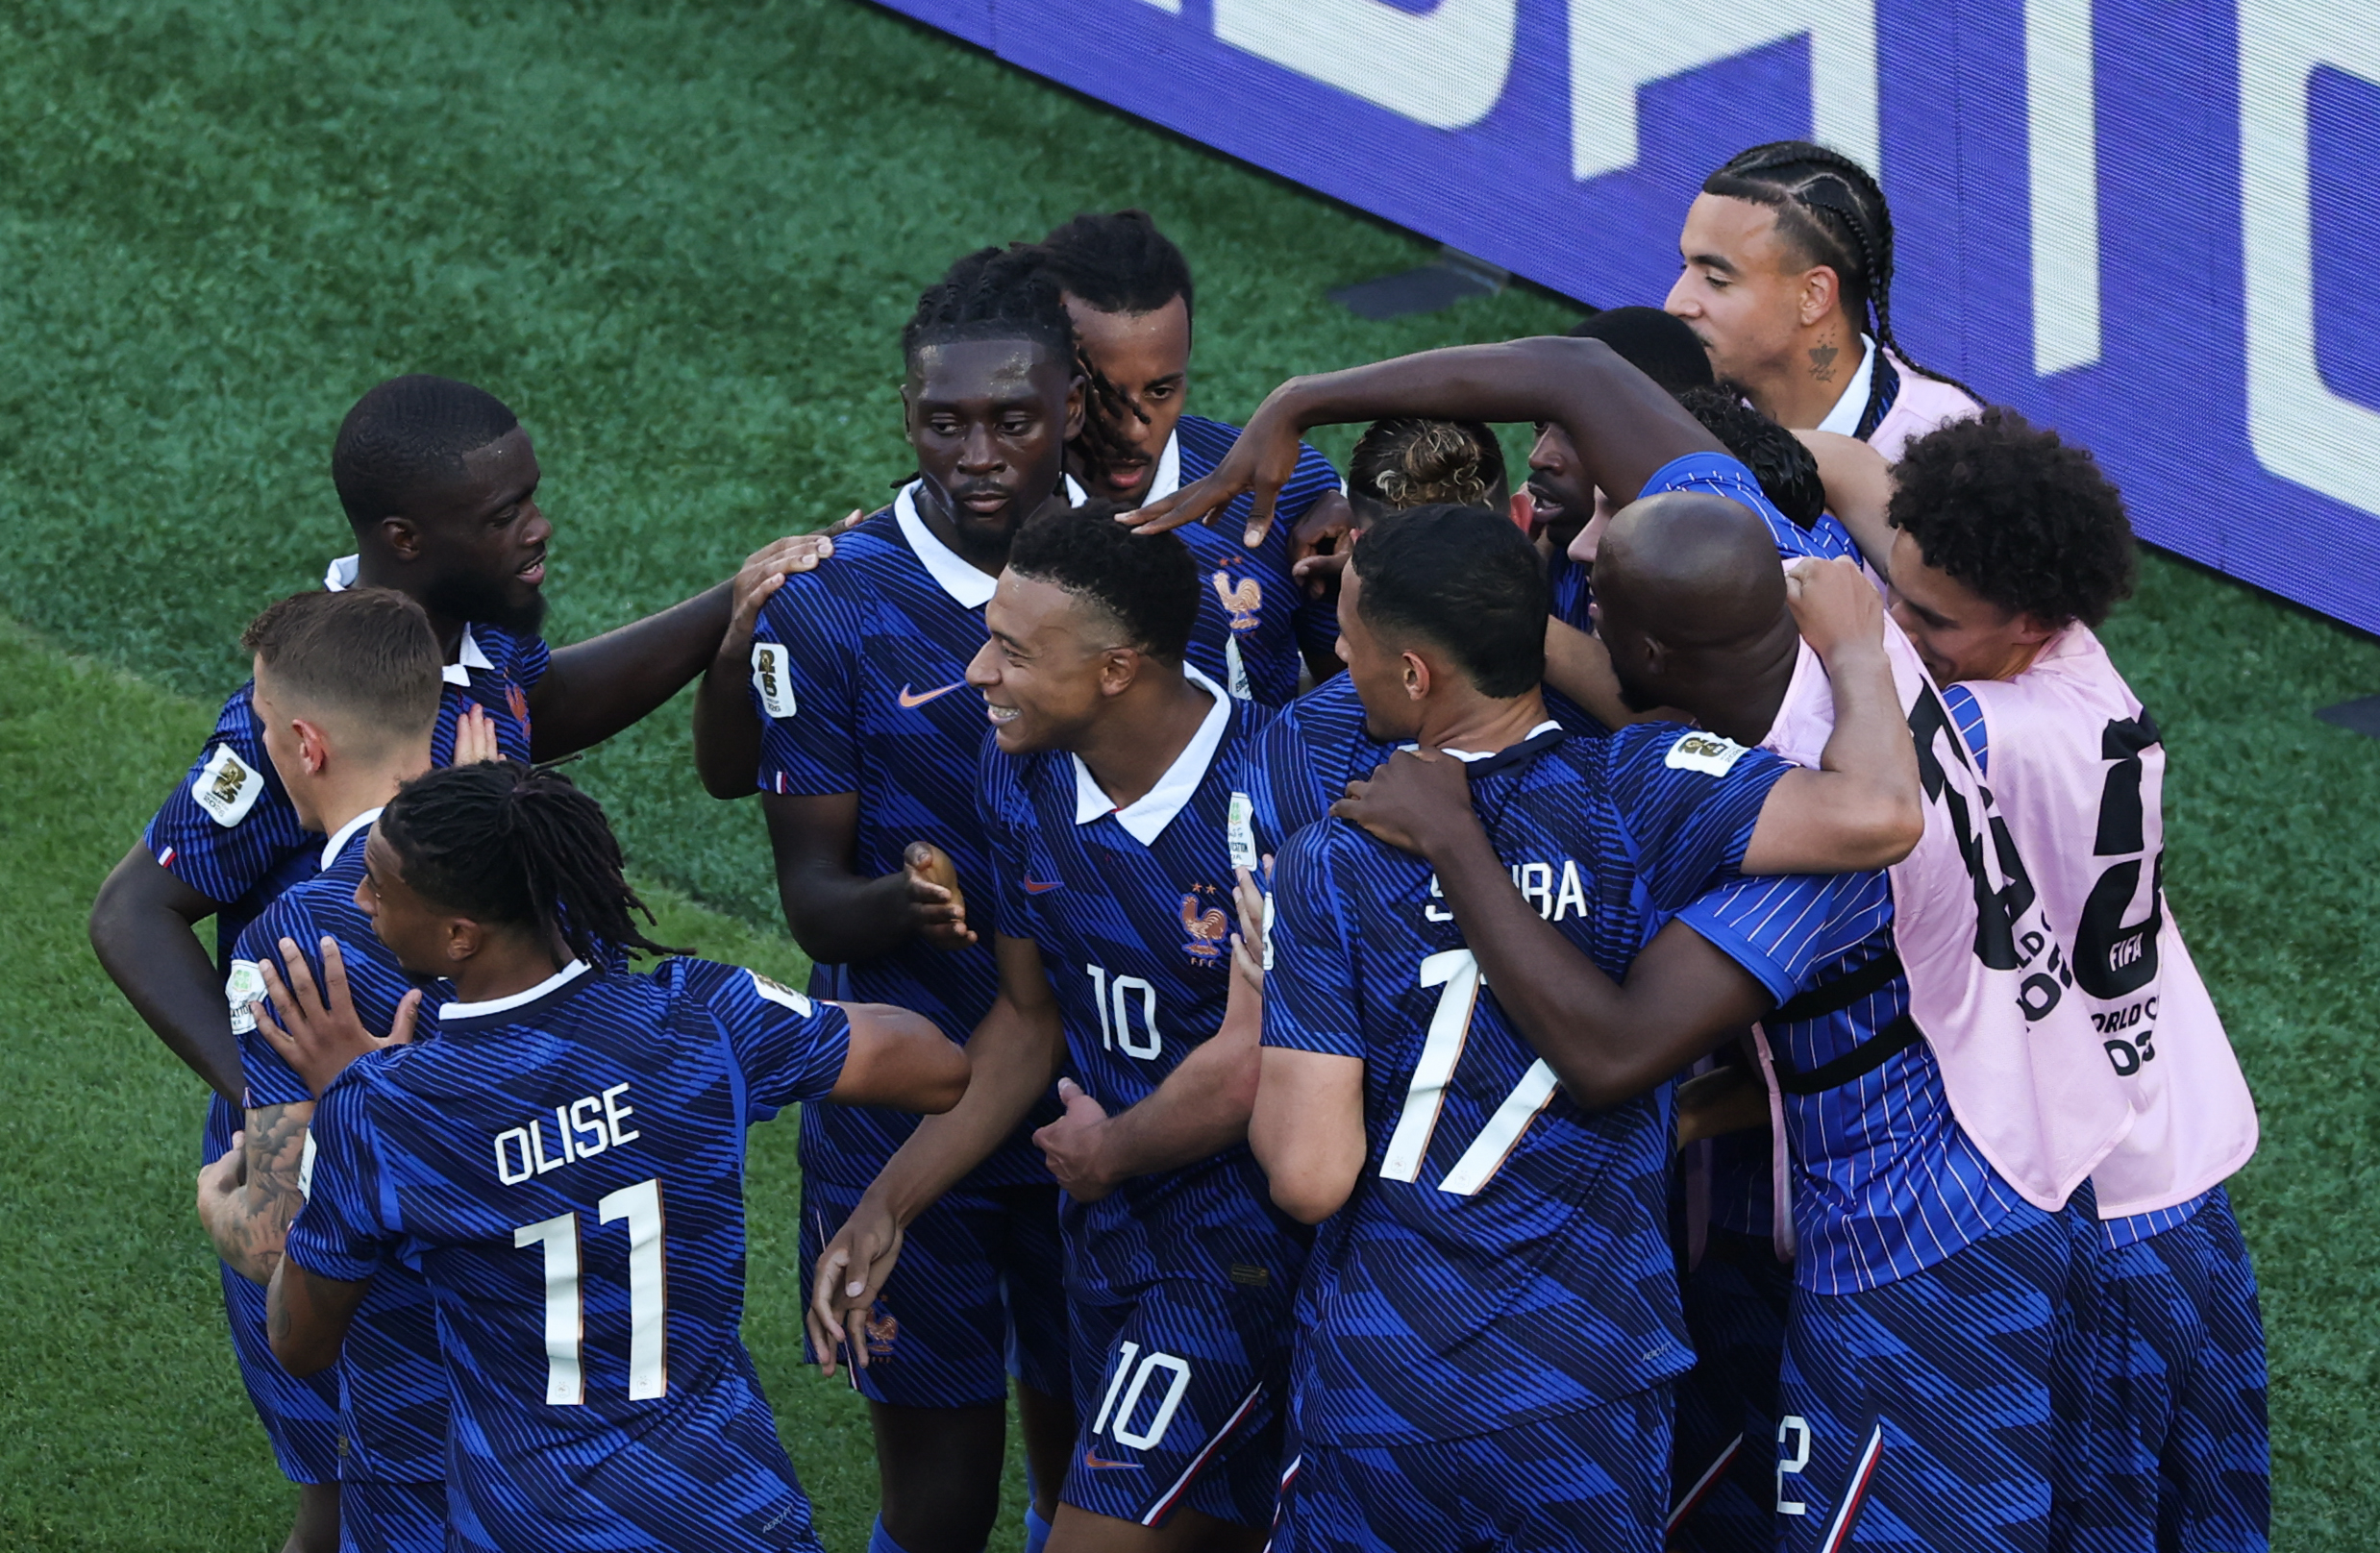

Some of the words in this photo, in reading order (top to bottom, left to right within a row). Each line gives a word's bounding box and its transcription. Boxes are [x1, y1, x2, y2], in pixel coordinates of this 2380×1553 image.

[2108, 931, 2144, 973] FIFA
[1086, 962, 1161, 1061] 10
[2090, 1002, 2142, 1034] ORLD
[493, 1081, 640, 1186] OLISE
[513, 1177, 668, 1406] 11
[1092, 1340, 1191, 1452] 10
